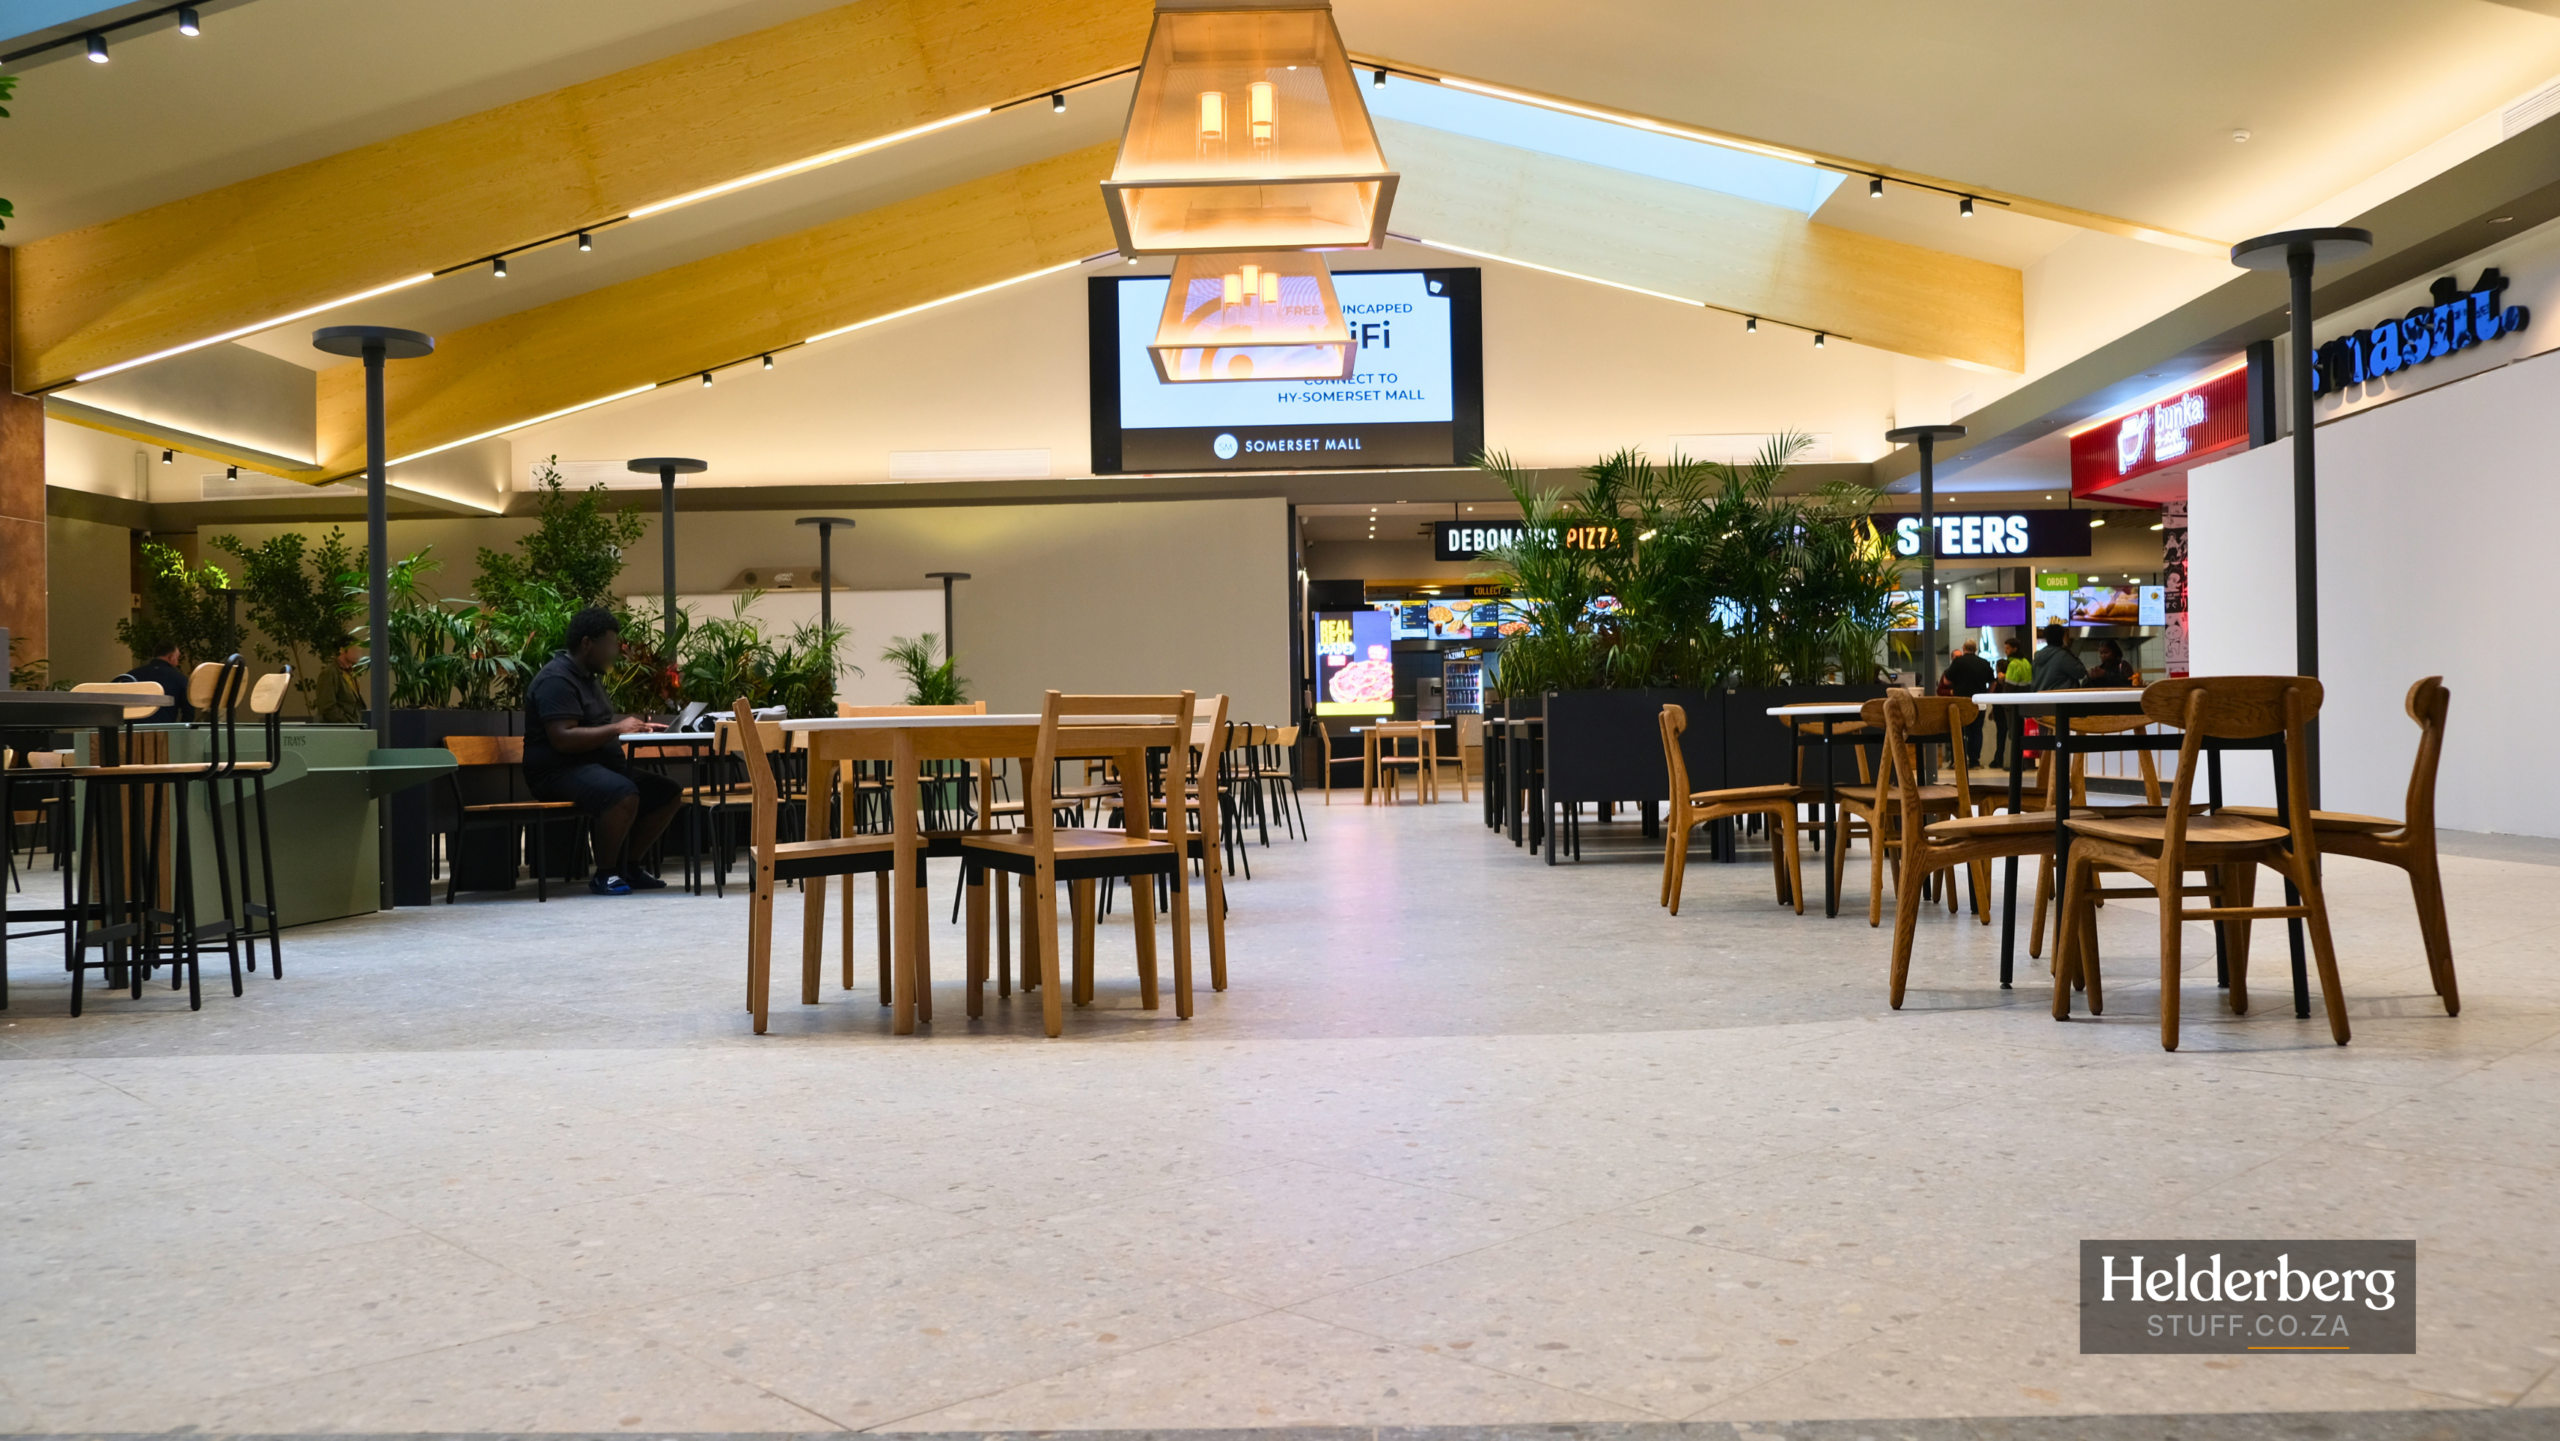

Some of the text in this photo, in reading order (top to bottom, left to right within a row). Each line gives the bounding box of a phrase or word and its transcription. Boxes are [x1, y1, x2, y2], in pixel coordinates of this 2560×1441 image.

[1285, 305, 1320, 316] FREE
[2313, 268, 2530, 400] masht.
[1378, 373, 1398, 384] TO
[1278, 389, 1425, 403] HY-SOMERSET MALL
[2155, 393, 2204, 435] bunka
[1245, 437, 1362, 453] SOMERSET MALL
[2046, 577, 2069, 587] ORDER
[1317, 641, 1356, 656] LOADED
[283, 736, 306, 747] TRAYS
